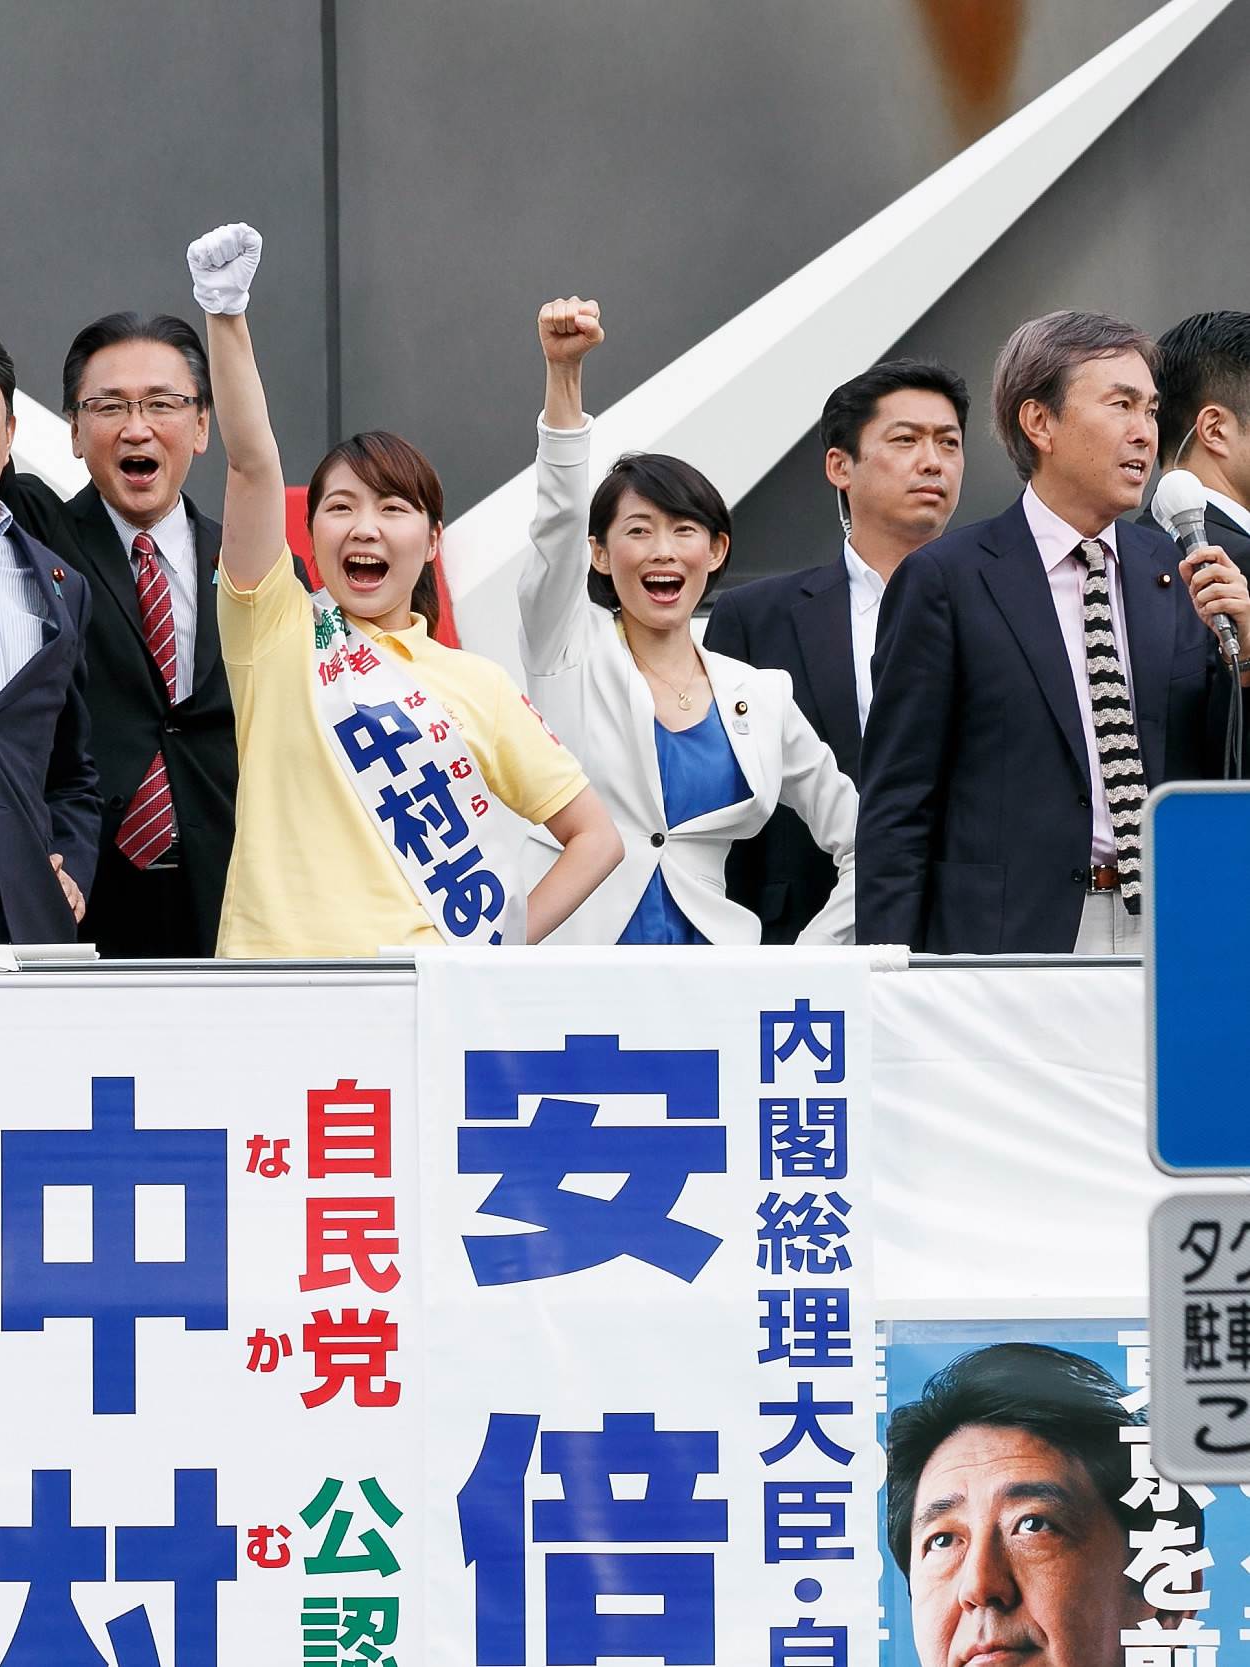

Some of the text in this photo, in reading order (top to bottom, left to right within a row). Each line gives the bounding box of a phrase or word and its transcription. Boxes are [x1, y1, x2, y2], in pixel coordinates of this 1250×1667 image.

[318, 644, 381, 686] 候者
[403, 690, 489, 818] なかむら
[333, 702, 506, 945] 中村あ
[298, 1078, 403, 1667] 自民党 公認
[456, 1034, 729, 1667] 安倍
